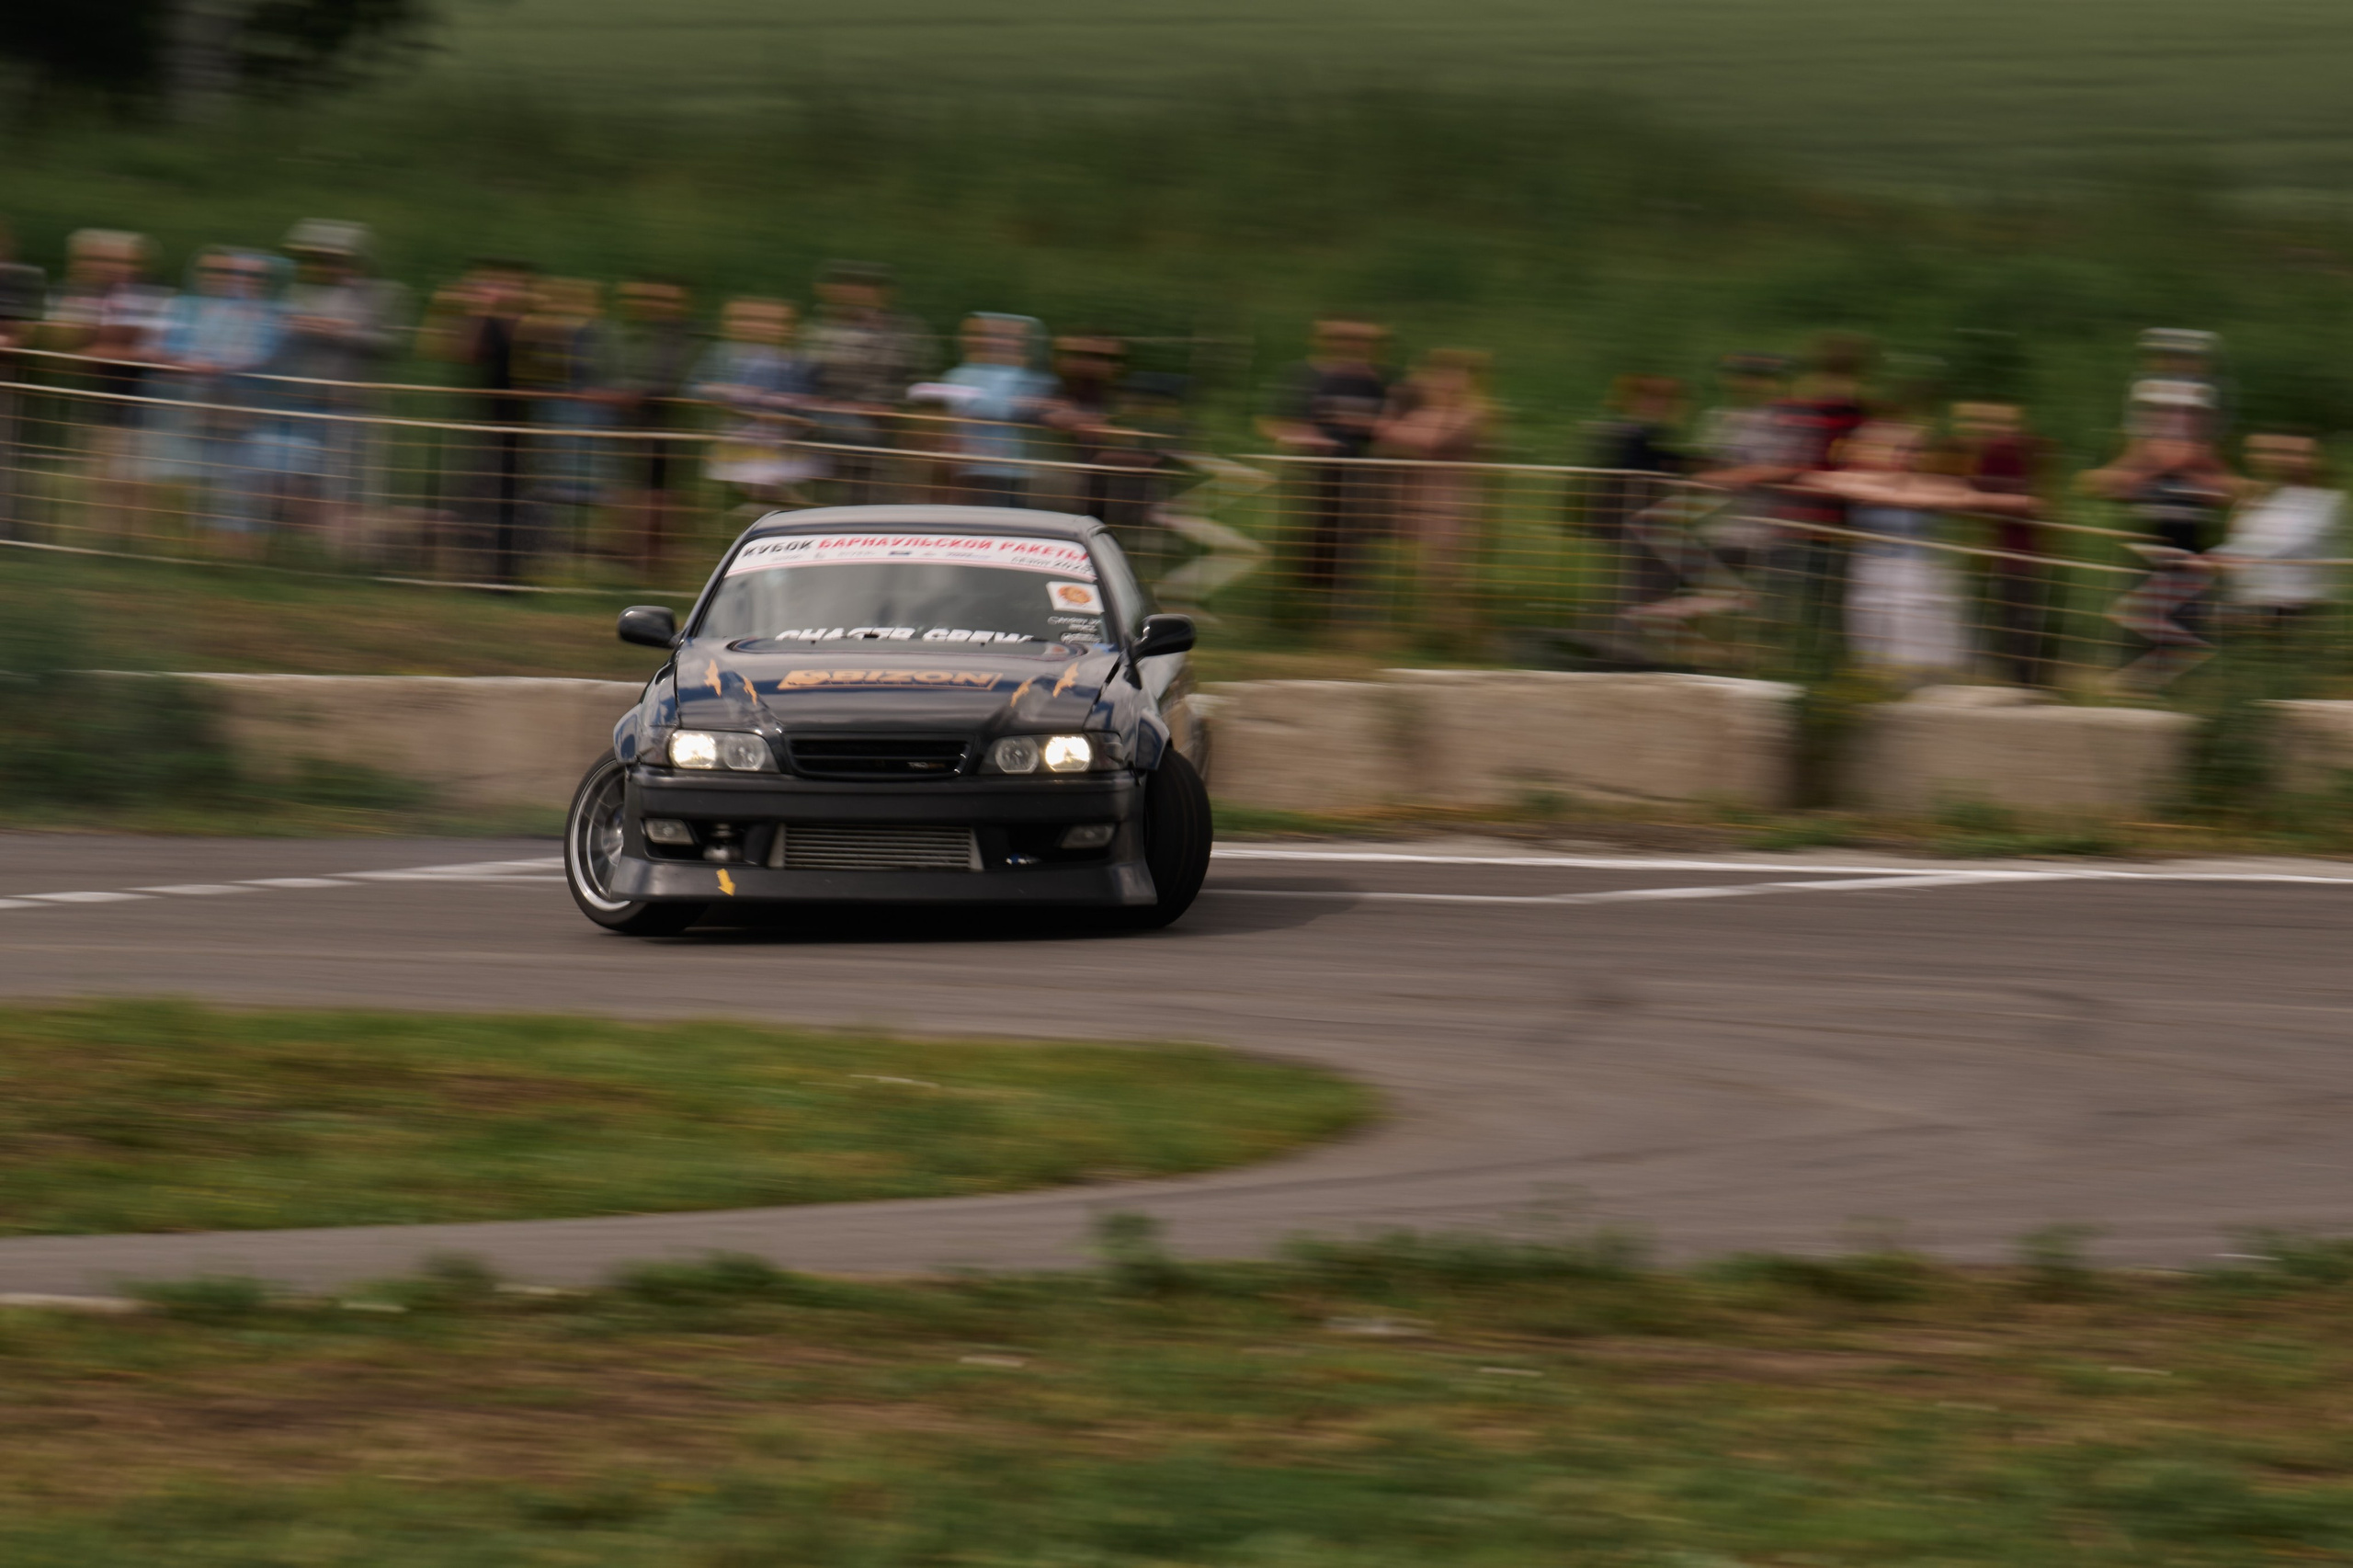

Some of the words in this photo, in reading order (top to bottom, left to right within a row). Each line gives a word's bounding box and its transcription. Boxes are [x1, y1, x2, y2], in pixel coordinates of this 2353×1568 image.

[743, 540, 814, 557] КУБОК
[817, 536, 993, 551] БАРНАУЛЬСКОЙ
[997, 541, 1089, 562] РАКЕТЫ
[829, 670, 995, 686] BIZON
